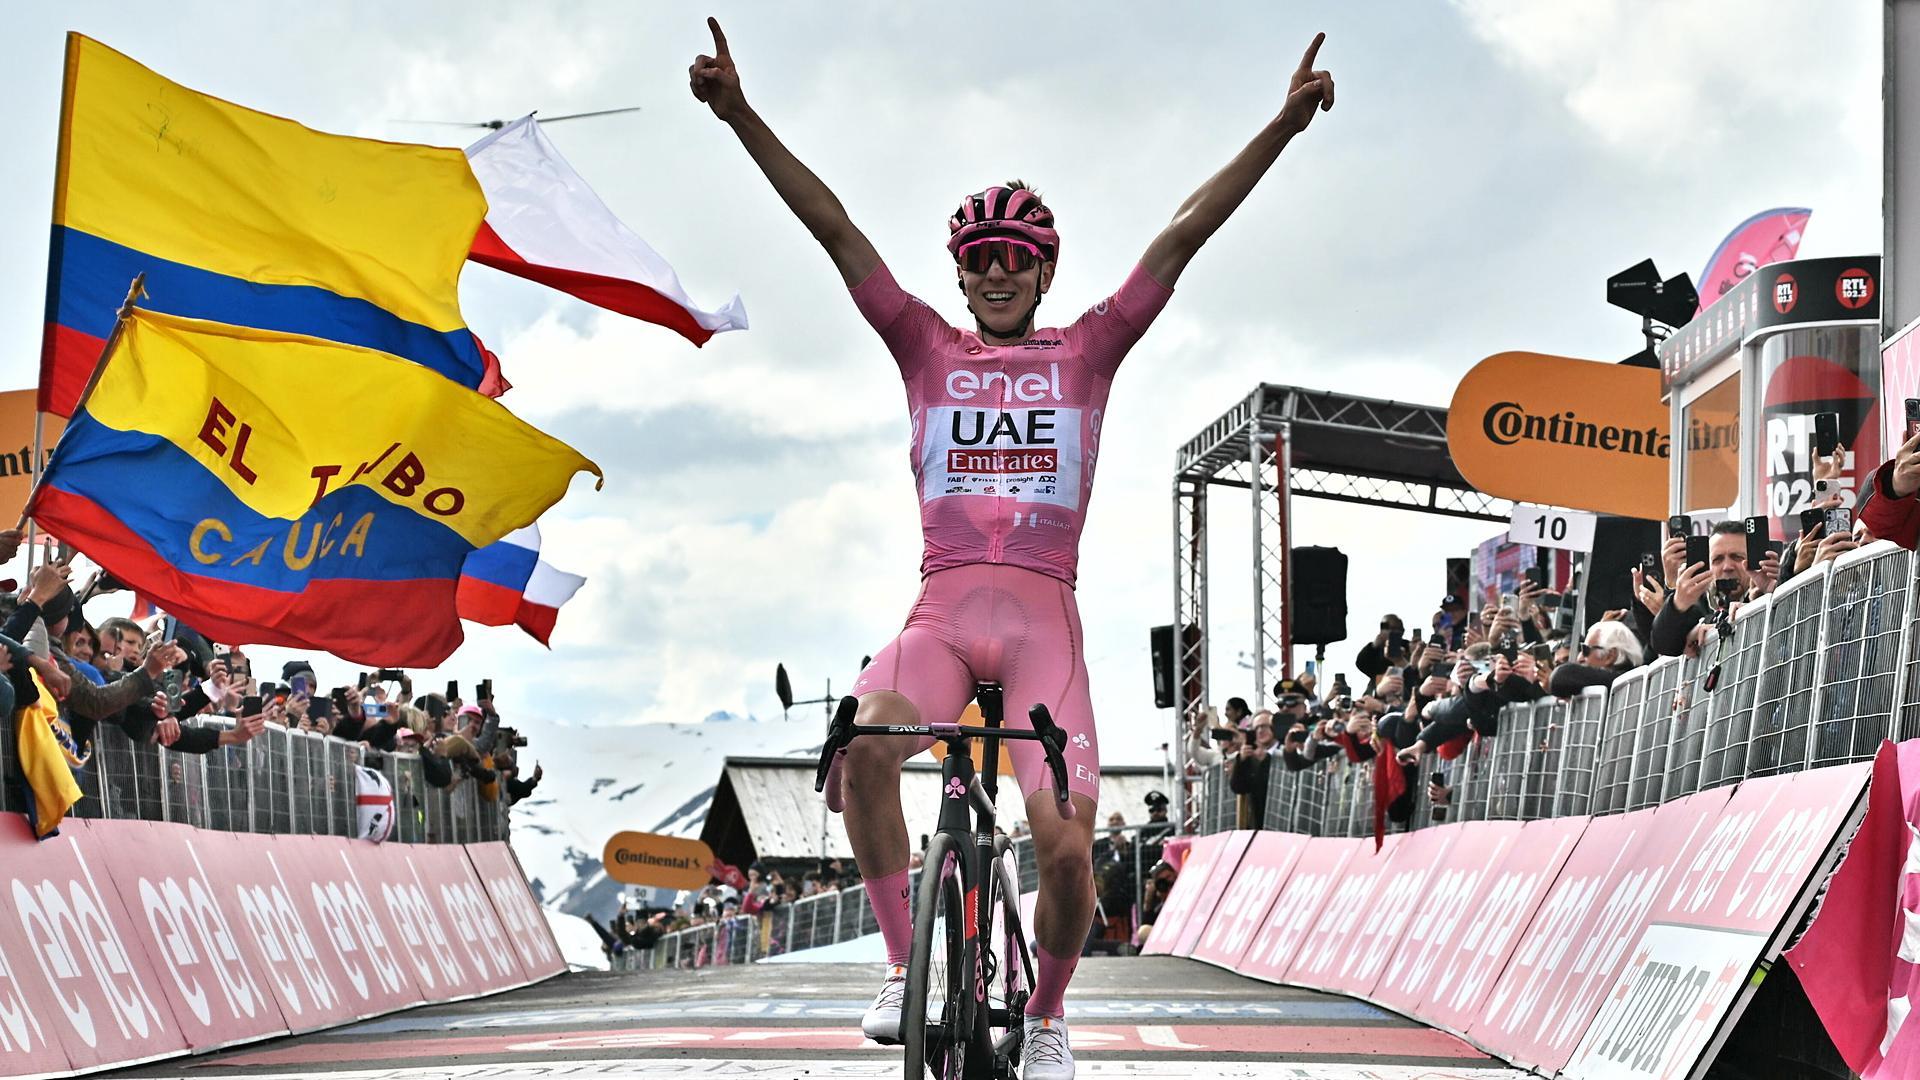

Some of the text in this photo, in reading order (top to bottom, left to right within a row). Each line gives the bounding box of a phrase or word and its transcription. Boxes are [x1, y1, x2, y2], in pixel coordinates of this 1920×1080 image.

[1776, 283, 1793, 297] RTL
[1842, 278, 1868, 291] RTL
[1842, 289, 1868, 299] 102.5
[198, 396, 258, 487] EL
[945, 363, 1063, 403] enel
[951, 409, 1056, 446] UAE
[1766, 412, 1855, 477] RT
[310, 442, 465, 516] TBO
[951, 452, 1055, 471] Emirates
[188, 511, 376, 572] CAUCA
[1533, 514, 1568, 541] 10
[614, 847, 689, 870] Continental
[1339, 836, 1451, 982] enel
[1668, 781, 1785, 913] enel
[1726, 775, 1857, 920] enel
[11, 835, 165, 1049] enel
[138, 839, 268, 1026] enel
[236, 850, 341, 1016] enel
[310, 849, 409, 1000] enel
[381, 855, 468, 989] enel
[440, 855, 517, 982] enel
[1296, 845, 1400, 978] enel
[1385, 835, 1508, 995] enel
[1432, 834, 1570, 1014] enel
[1484, 830, 1637, 1036] enel
[1533, 812, 1708, 1050] enel
[1597, 960, 1712, 1074] TUDOR
